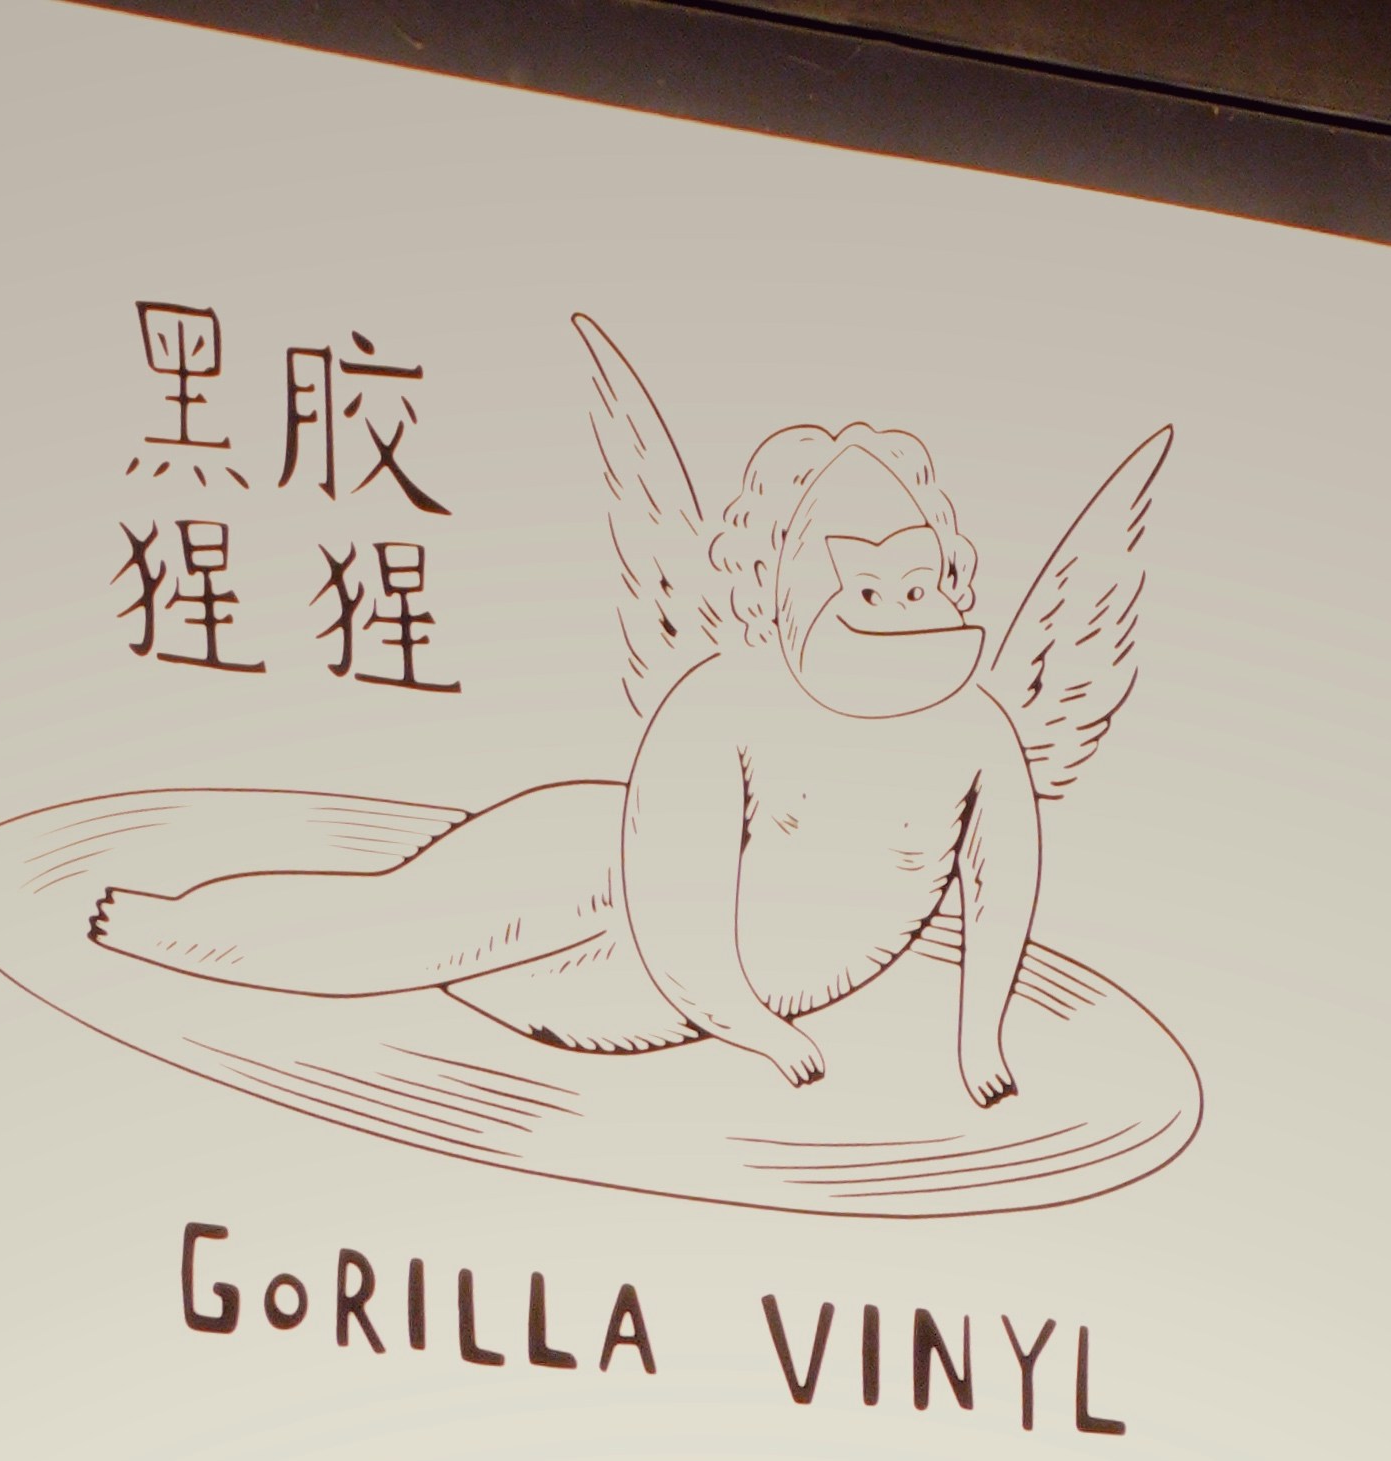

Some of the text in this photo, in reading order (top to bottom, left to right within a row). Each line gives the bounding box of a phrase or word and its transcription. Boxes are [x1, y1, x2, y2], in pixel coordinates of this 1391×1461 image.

[125, 300, 453, 516] 黑胶
[110, 517, 462, 695] 猩猩
[761, 1293, 1127, 1437] VINYL
